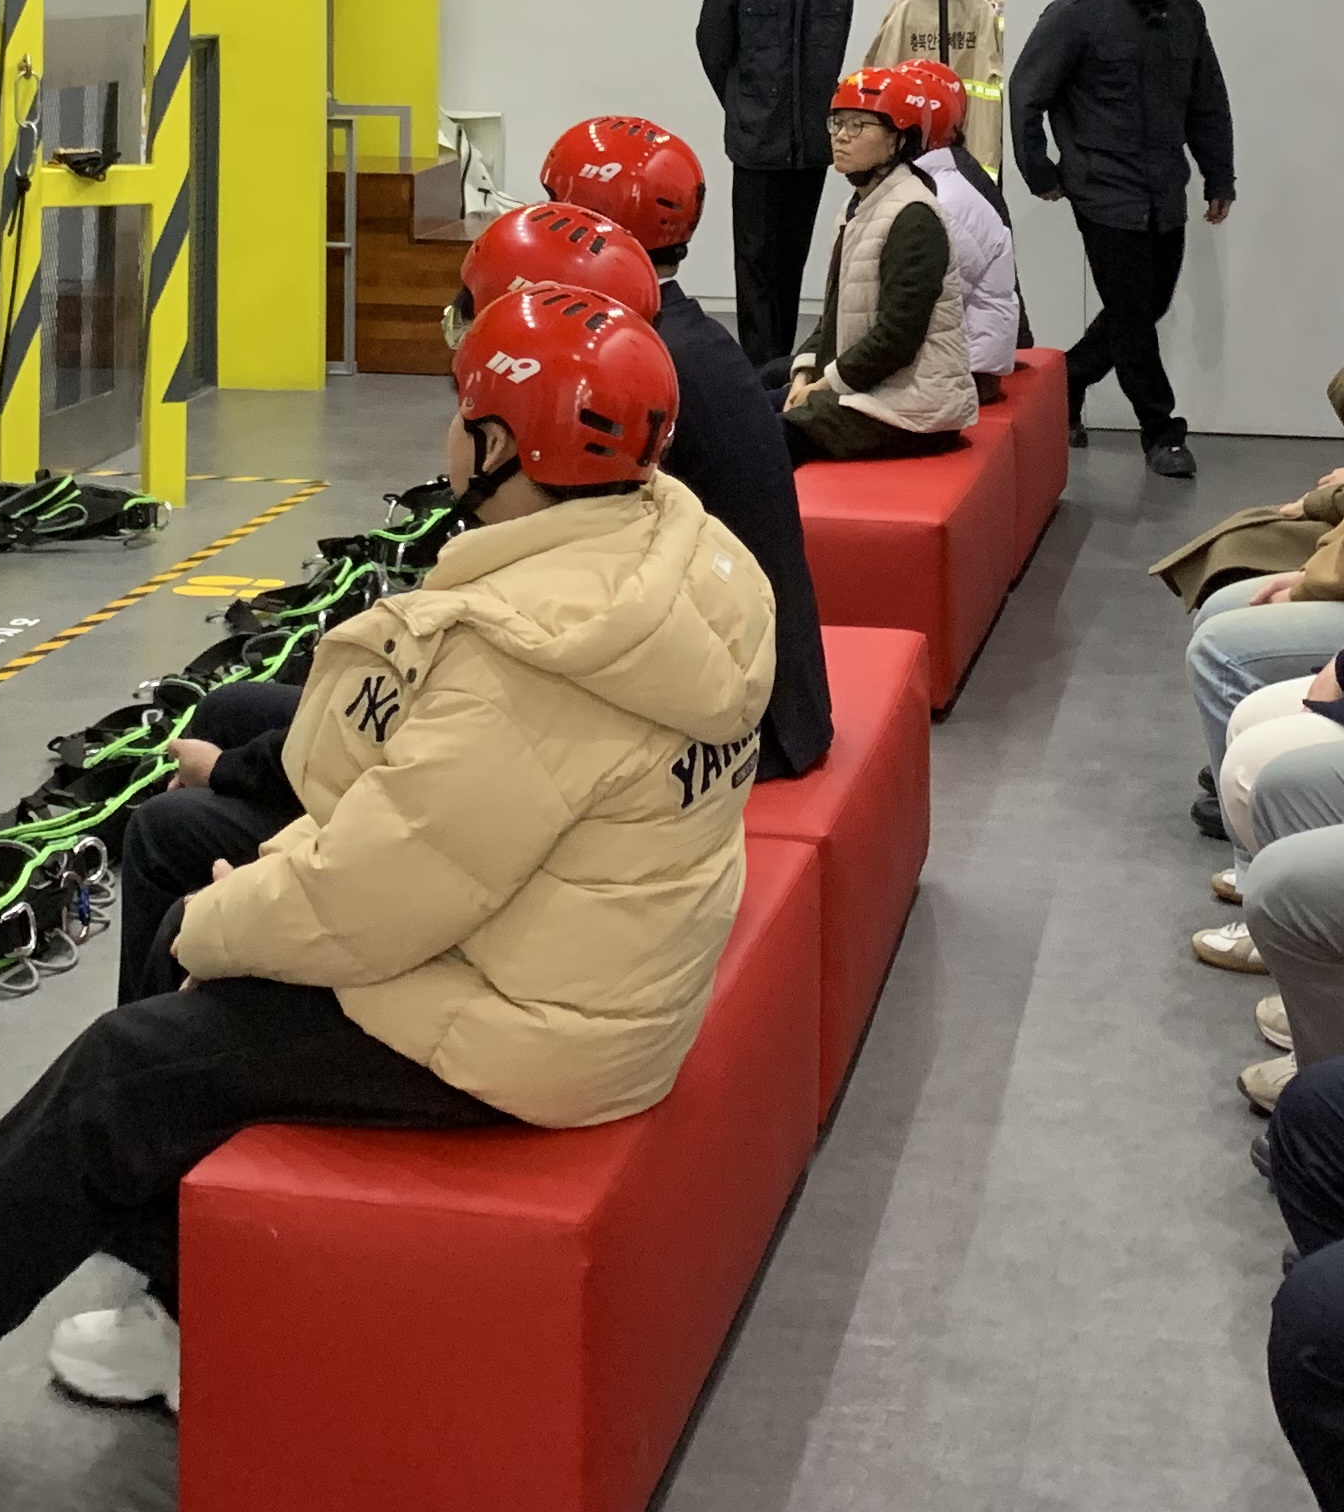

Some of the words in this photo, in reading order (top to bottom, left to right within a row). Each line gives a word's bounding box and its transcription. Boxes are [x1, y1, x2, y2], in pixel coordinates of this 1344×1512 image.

[910, 31, 977, 51] 충북안체험관
[578, 162, 623, 182] 119
[485, 350, 542, 384] 119
[344, 675, 400, 742] NY
